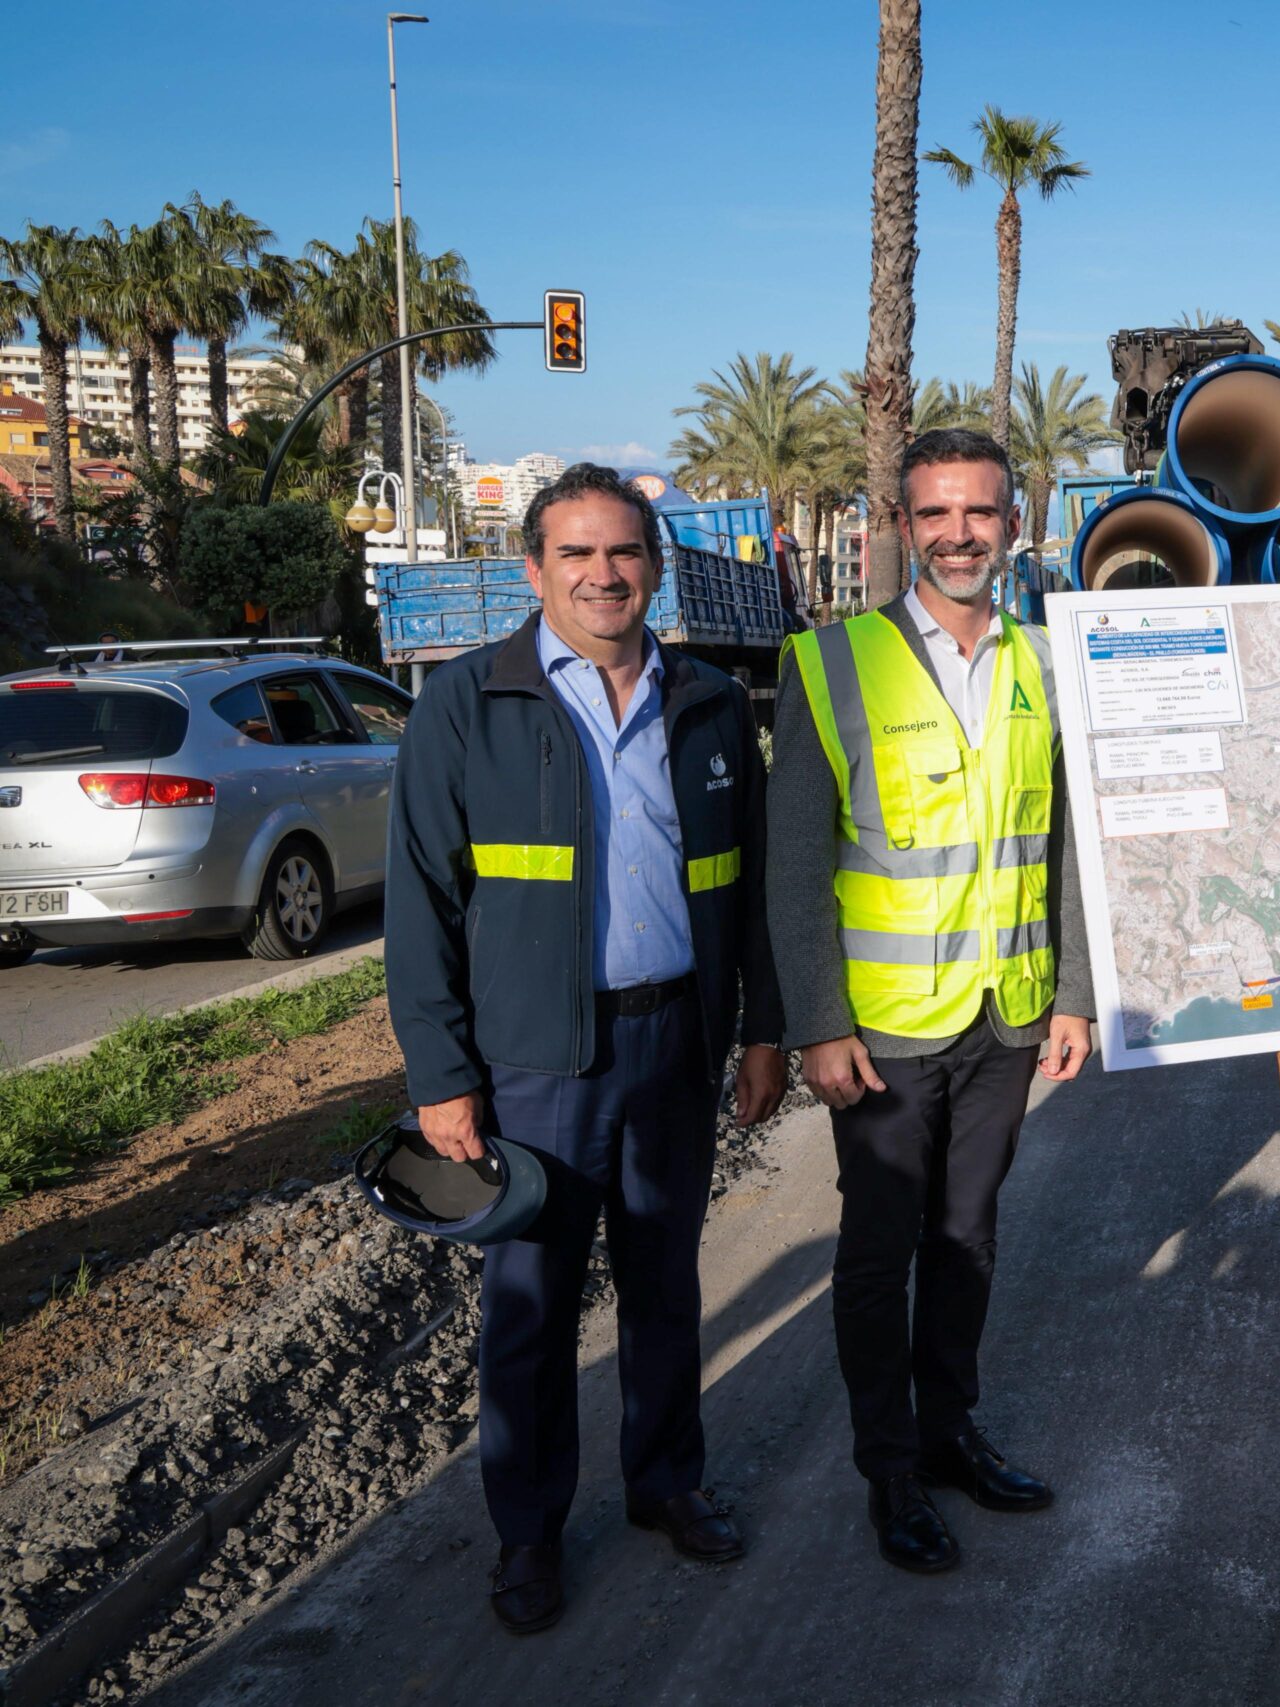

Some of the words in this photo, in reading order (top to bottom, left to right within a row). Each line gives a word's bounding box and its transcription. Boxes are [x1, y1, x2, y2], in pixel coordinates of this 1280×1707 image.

[477, 491, 504, 499] KING
[883, 720, 938, 735] Consejero
[707, 776, 734, 791] ACOSO
[28, 841, 53, 849] XL
[25, 892, 63, 912] FSH
